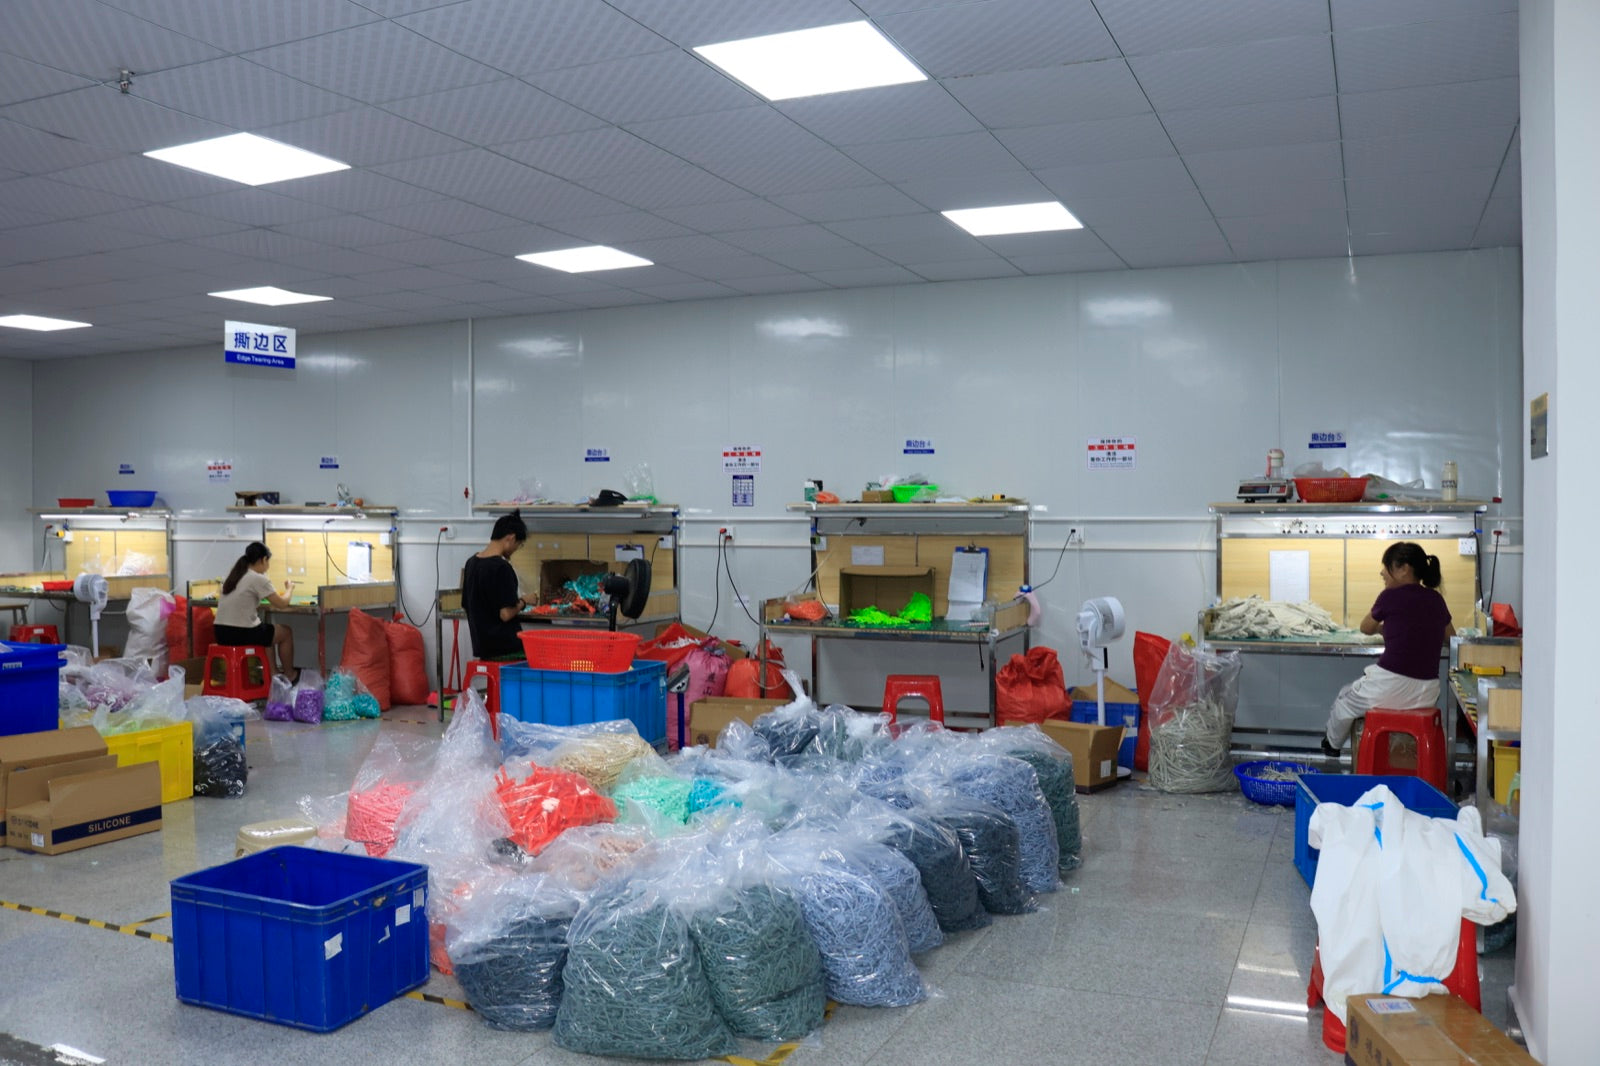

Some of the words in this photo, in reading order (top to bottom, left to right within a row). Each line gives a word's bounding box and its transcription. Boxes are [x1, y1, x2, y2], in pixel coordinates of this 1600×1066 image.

[234, 332, 287, 353] 撕边区
[236, 354, 251, 362] Edge
[252, 355, 271, 365] Tearing
[271, 357, 285, 365] Area
[88, 816, 131, 832] SILICONE
